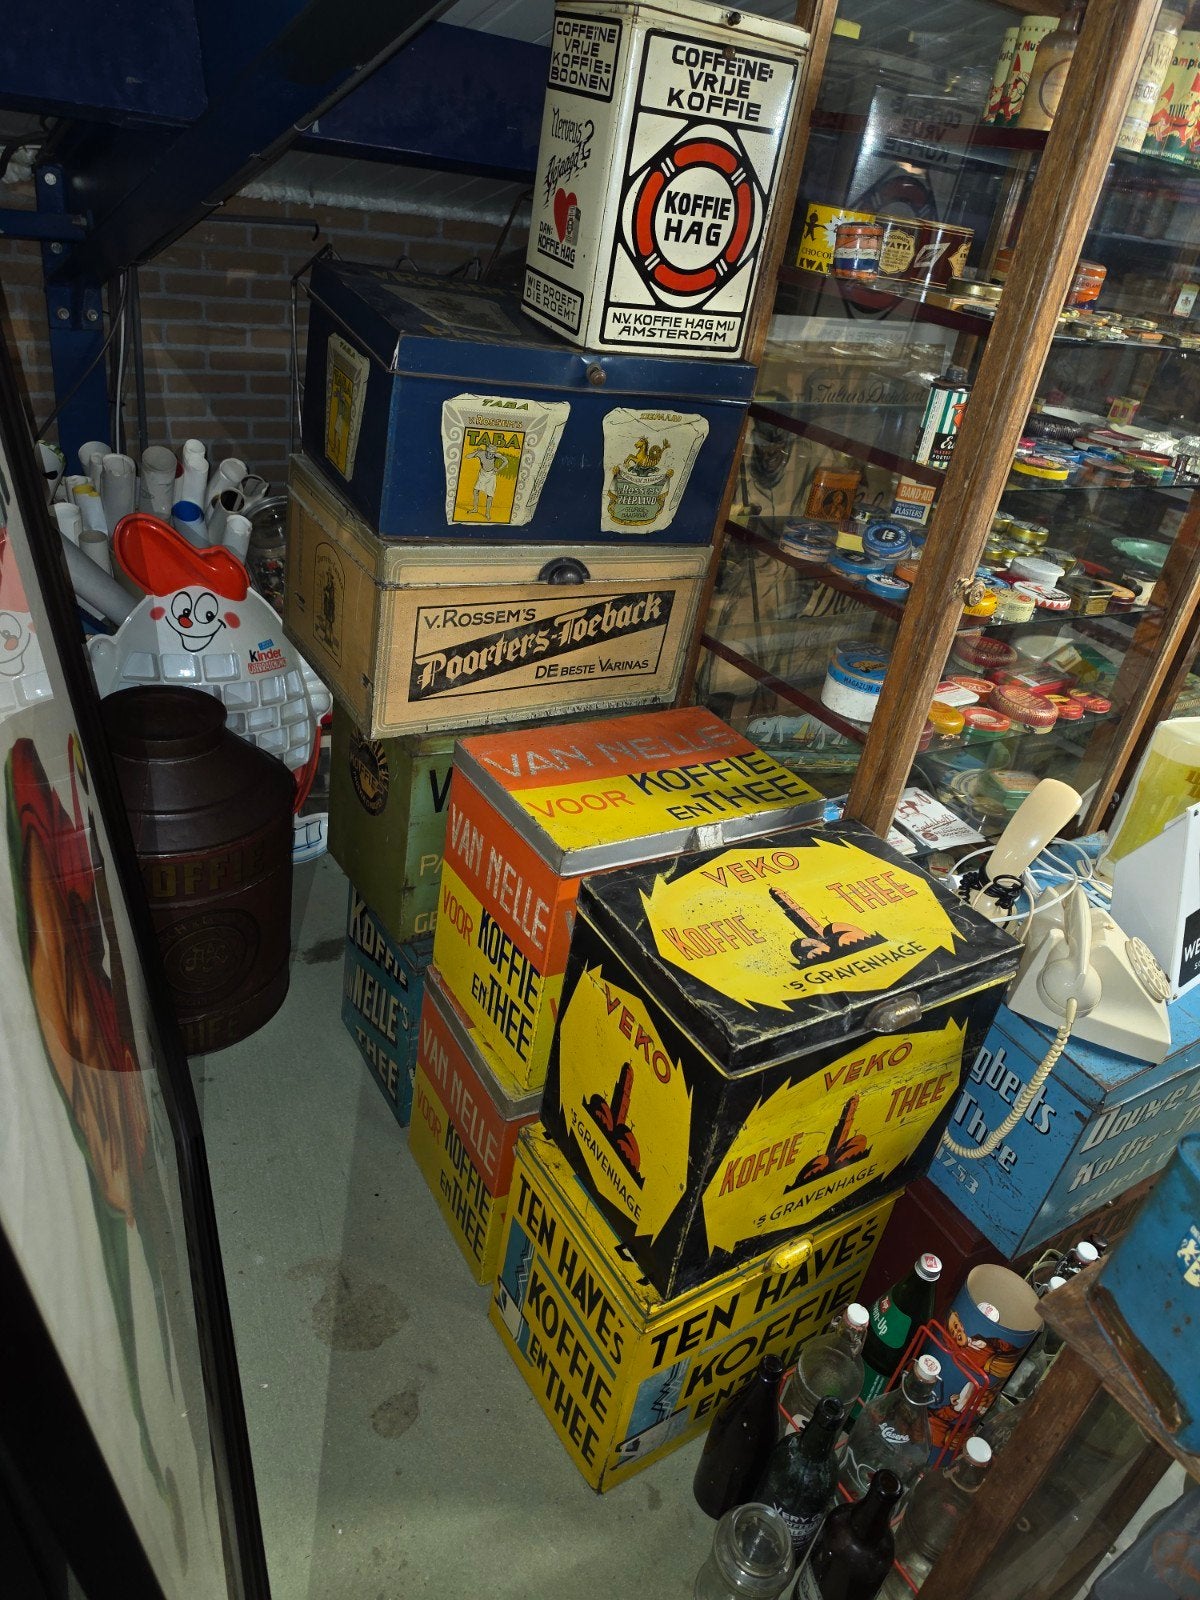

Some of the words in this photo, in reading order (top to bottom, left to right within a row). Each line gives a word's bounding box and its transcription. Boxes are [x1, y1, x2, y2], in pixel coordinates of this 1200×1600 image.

[564, 38, 600, 57] VRIJE
[550, 66, 610, 92] BOONEN
[666, 87, 762, 122] KOFFIE
[688, 69, 751, 99] VRIJE
[663, 190, 733, 221] KOFFIE
[663, 218, 723, 247] HAG
[537, 233, 560, 258] KOFFIE
[560, 243, 576, 264] HAG
[526, 287, 541, 304] DIE
[540, 295, 577, 323] ROEMT
[527, 274, 542, 291] WIE
[542, 284, 578, 311] PROEFT
[612, 312, 631, 324] N.V.
[633, 313, 683, 328] KOFFIE
[685, 318, 715, 331] HAG
[715, 320, 736, 332] MIJ
[618, 326, 727, 342] AMSTERDAM
[481, 399, 529, 411] TABA
[467, 430, 521, 449] TABA
[894, 506, 922, 519] PLASTERS
[900, 485, 934, 502] BAND-AID
[415, 592, 664, 690] Poorters-Toeback
[534, 664, 558, 680] DE
[843, 676, 873, 692] MAGAZIJN
[482, 744, 594, 777] VAN
[596, 724, 739, 763] NELLE
[526, 790, 635, 818] VOOR
[627, 751, 783, 796] KOFFIE
[449, 801, 485, 878] VAN
[485, 845, 551, 950] NELLE
[701, 851, 800, 888] VEKO
[348, 886, 408, 992] KOFFIE
[662, 915, 767, 961] KOFFIE
[826, 870, 918, 914] THEE
[442, 884, 474, 946] VOOR
[477, 906, 542, 1015] KOFFIE
[805, 940, 927, 985] GRAVENHAGE
[487, 972, 533, 1063] THEE
[604, 982, 671, 1084] VEKO
[355, 1025, 399, 1106] THEE
[824, 1041, 913, 1092] VEKO
[422, 1017, 448, 1090] VAN
[451, 1071, 499, 1177] NELLE
[1080, 1084, 1188, 1155] Douwe
[415, 1084, 442, 1145] VOOR
[444, 1117, 492, 1227] KOFFIE
[719, 1131, 804, 1197] KOFFIE
[885, 1071, 953, 1123] THEE
[1068, 1132, 1160, 1193] Koffie
[577, 1126, 641, 1220] GRAVENHAGE
[769, 1163, 878, 1222] GRAVENHAGE
[447, 1183, 485, 1263] THEE
[519, 1173, 557, 1257] TEN
[528, 1270, 612, 1425] KOFFIE
[651, 1293, 741, 1369] TEN
[683, 1270, 862, 1400] KOFFIE
[545, 1359, 600, 1469] THEE
